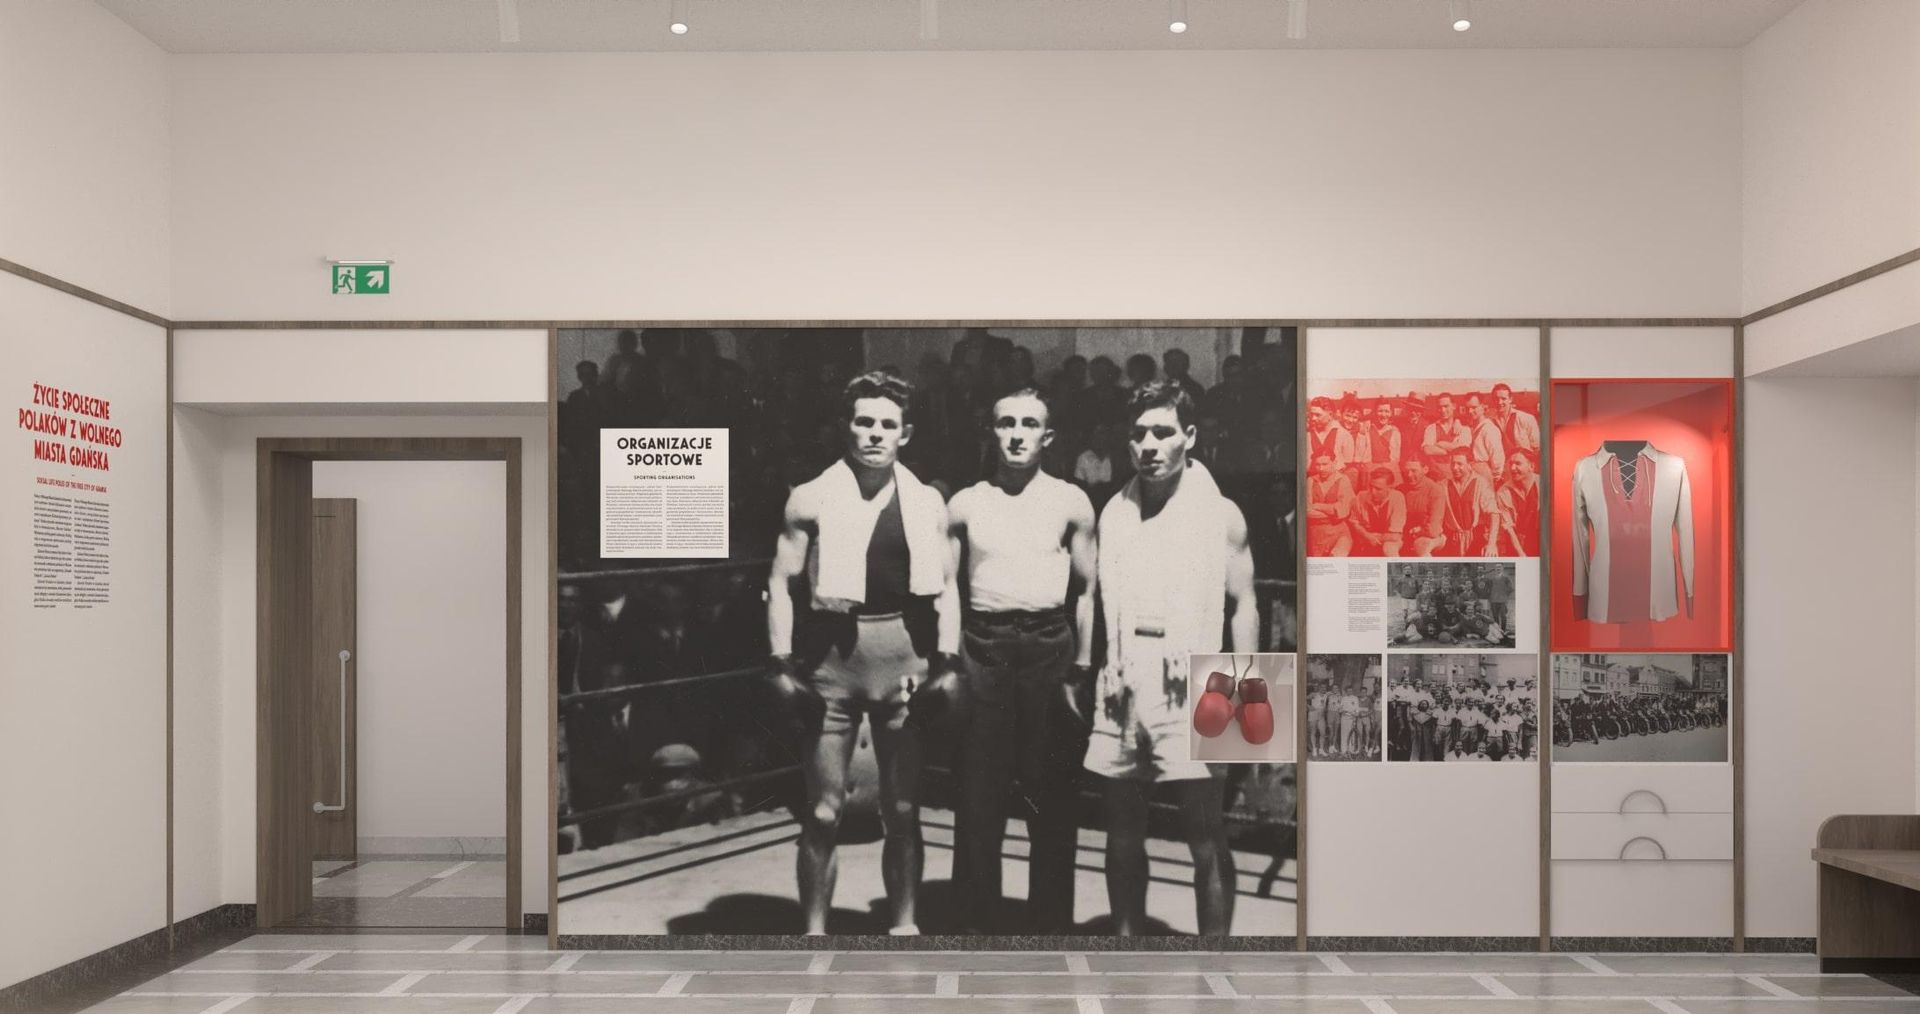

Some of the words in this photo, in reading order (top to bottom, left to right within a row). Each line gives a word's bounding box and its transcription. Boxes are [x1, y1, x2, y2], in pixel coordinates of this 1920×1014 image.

[33, 381, 59, 408] ŻYCIE
[62, 391, 110, 420] SPOŁECZNE
[18, 408, 67, 437] POLAKÓW
[70, 420, 76, 439] Z
[79, 421, 122, 448] WOLNEGO
[617, 437, 712, 450] ORGANIZACJE
[34, 439, 66, 464] MIASTA
[69, 446, 109, 471] GDAŃSKA
[627, 453, 703, 466] SPORTOWE
